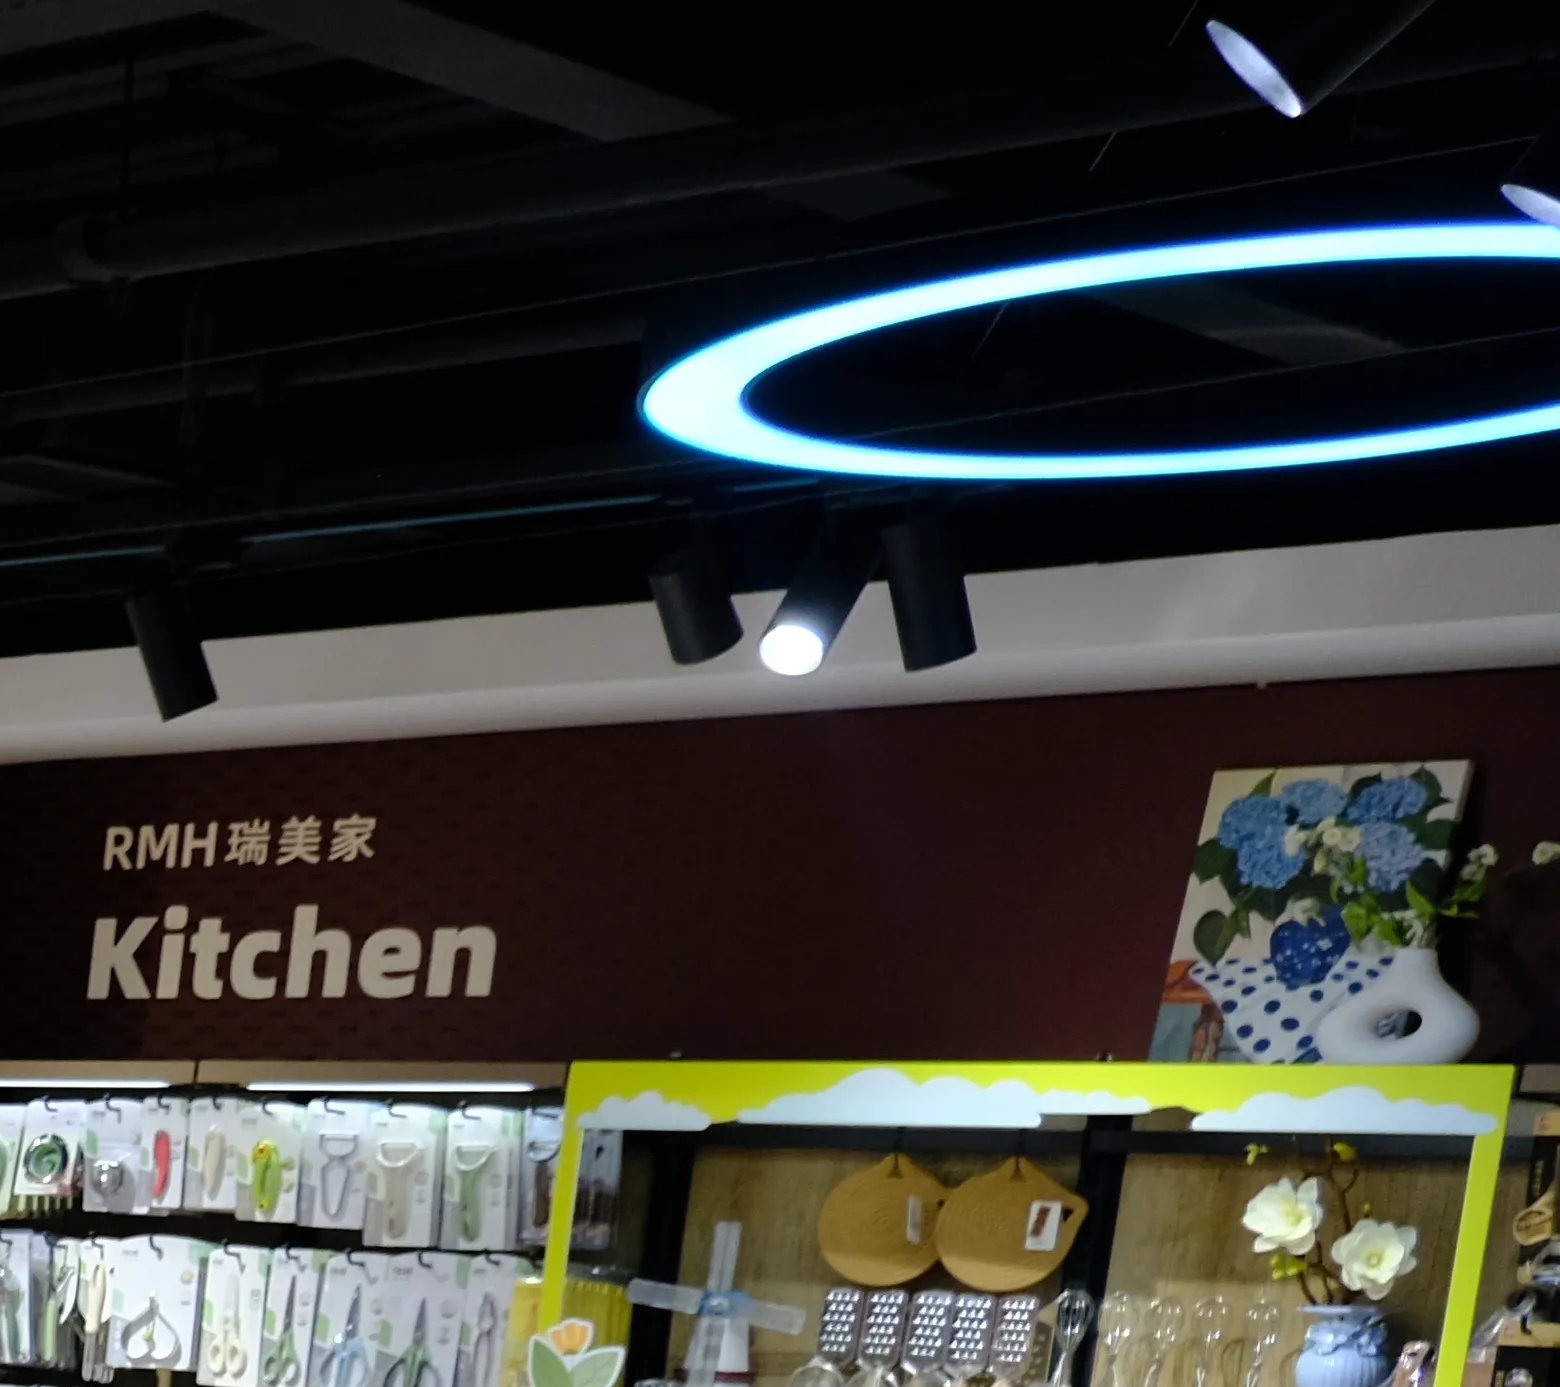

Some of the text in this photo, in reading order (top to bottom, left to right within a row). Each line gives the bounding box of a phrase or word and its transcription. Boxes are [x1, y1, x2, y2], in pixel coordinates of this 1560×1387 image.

[103, 814, 377, 871] RMH瑞美家
[87, 904, 497, 1001] Kitchen
